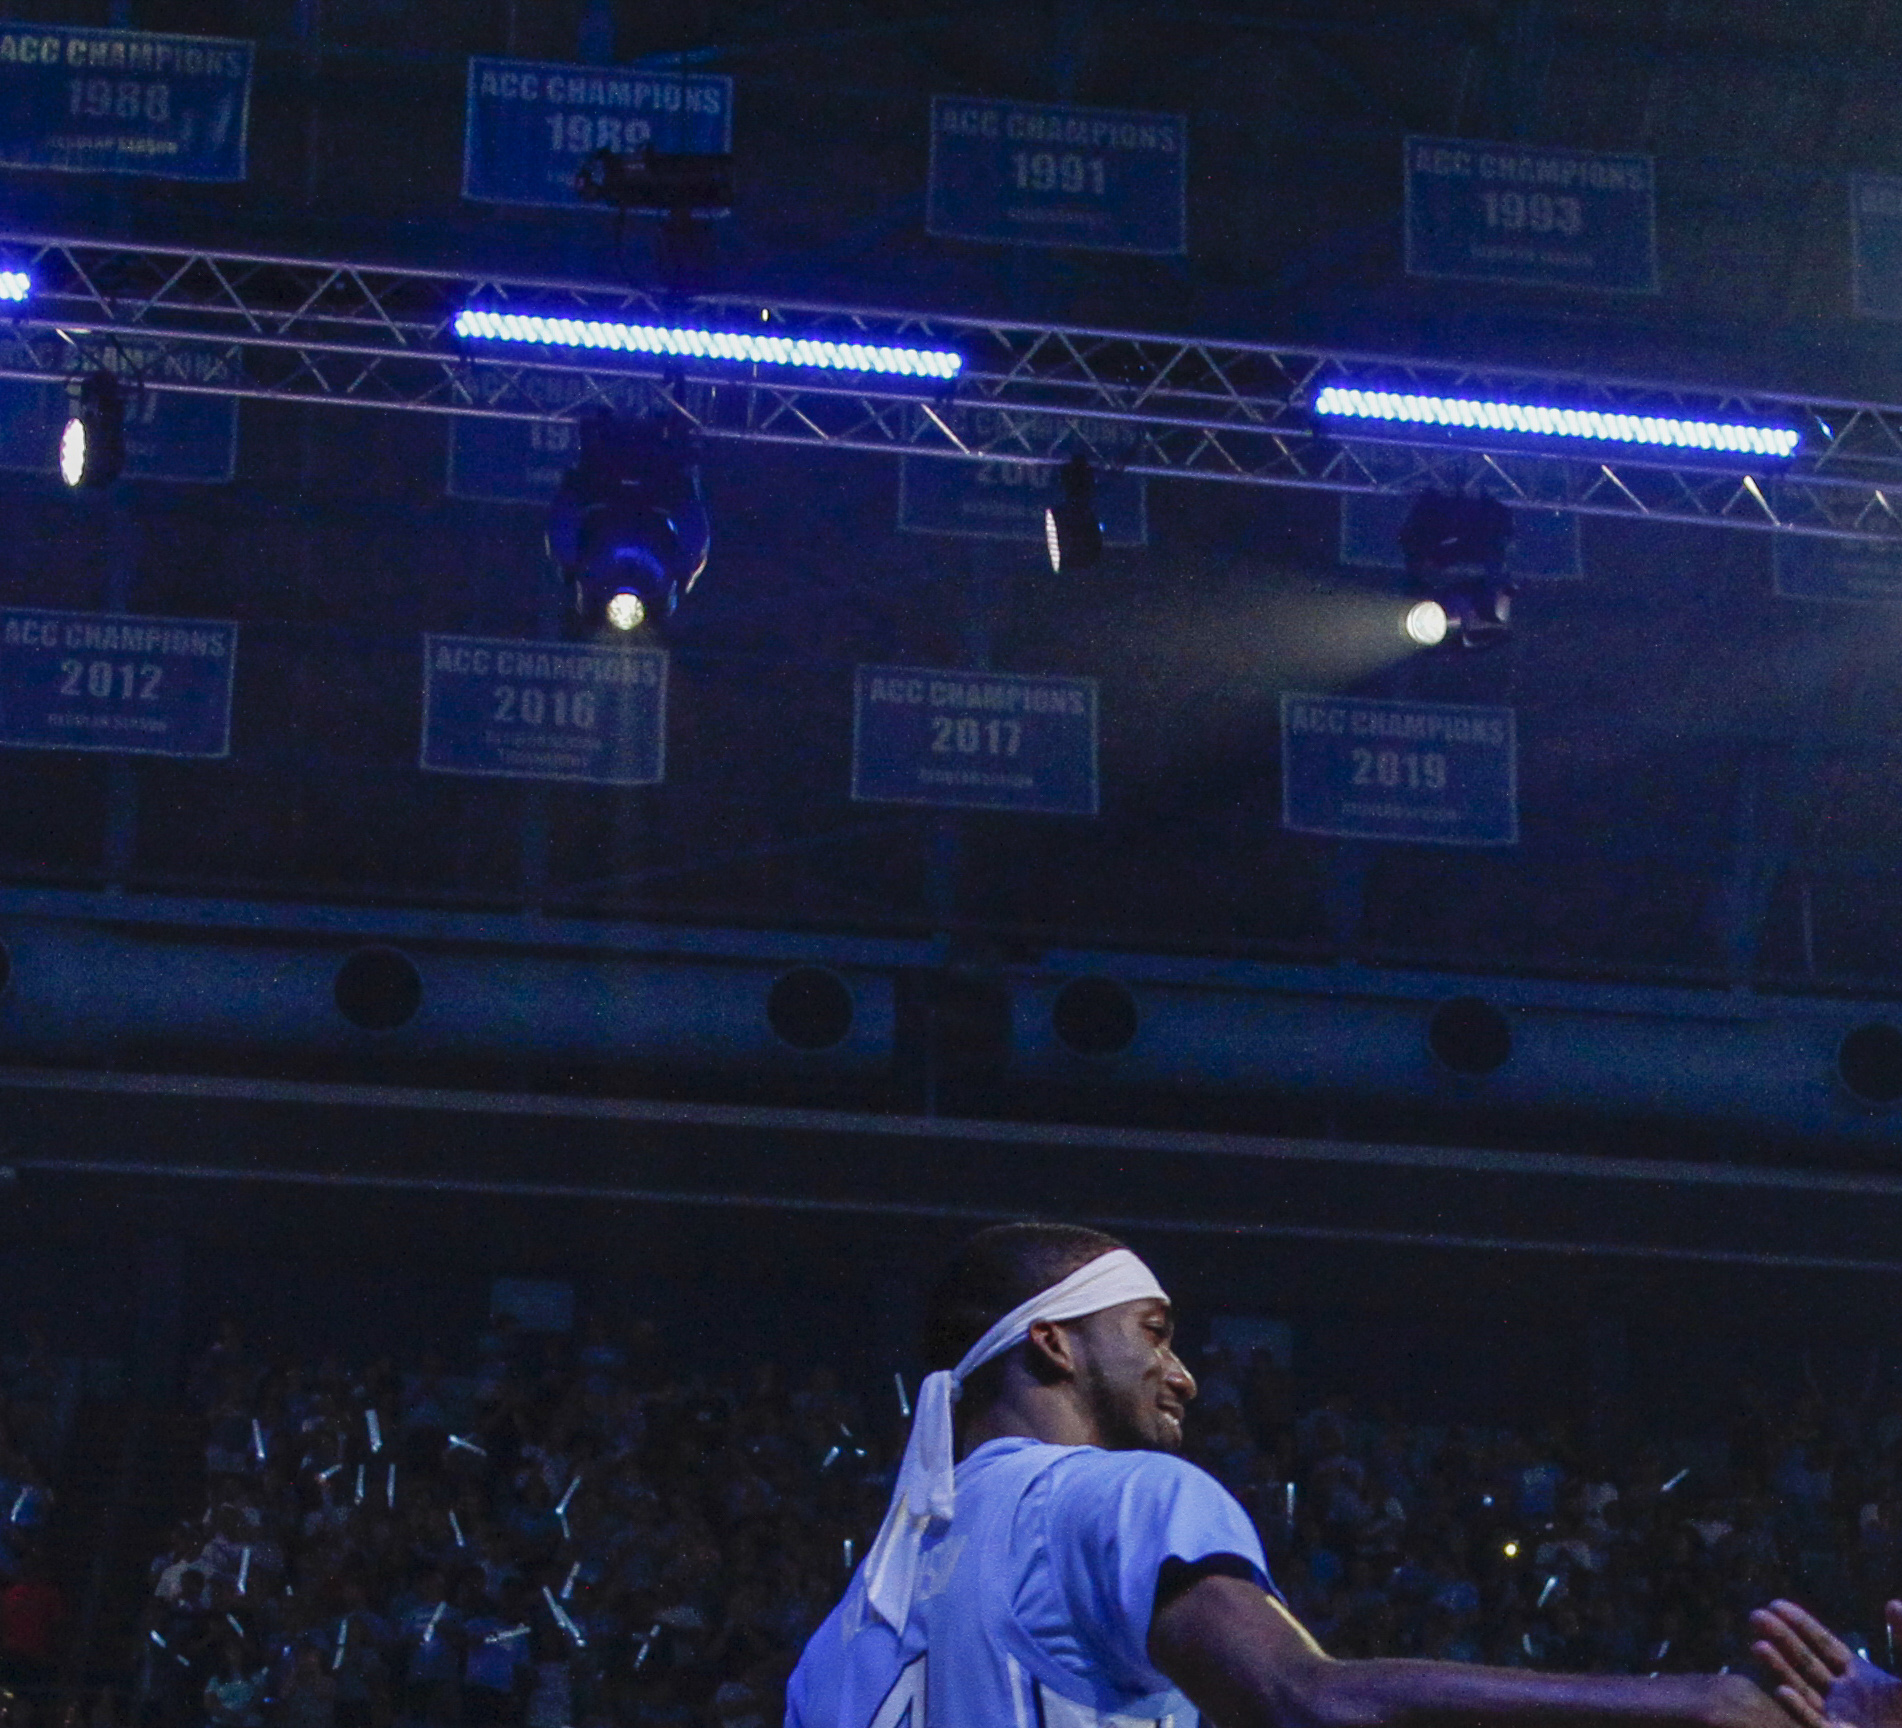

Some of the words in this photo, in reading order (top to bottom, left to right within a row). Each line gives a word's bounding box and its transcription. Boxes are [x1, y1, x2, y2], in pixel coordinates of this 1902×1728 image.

[0, 34, 62, 64] ACC
[66, 38, 243, 78] CHAMPIONS
[480, 69, 539, 100] ACC
[546, 76, 721, 115] CHAMPIONS
[1012, 152, 1106, 195] 1991
[5, 615, 60, 648] ACC
[65, 622, 227, 658] CHAMPIONS
[59, 659, 165, 701] 2012
[435, 645, 492, 675] ACC
[493, 683, 597, 729] 2016
[869, 676, 925, 705] ACC
[929, 680, 1086, 717] CHAMPIONS
[931, 714, 1023, 758] 2017
[1351, 747, 1447, 790] 2019
